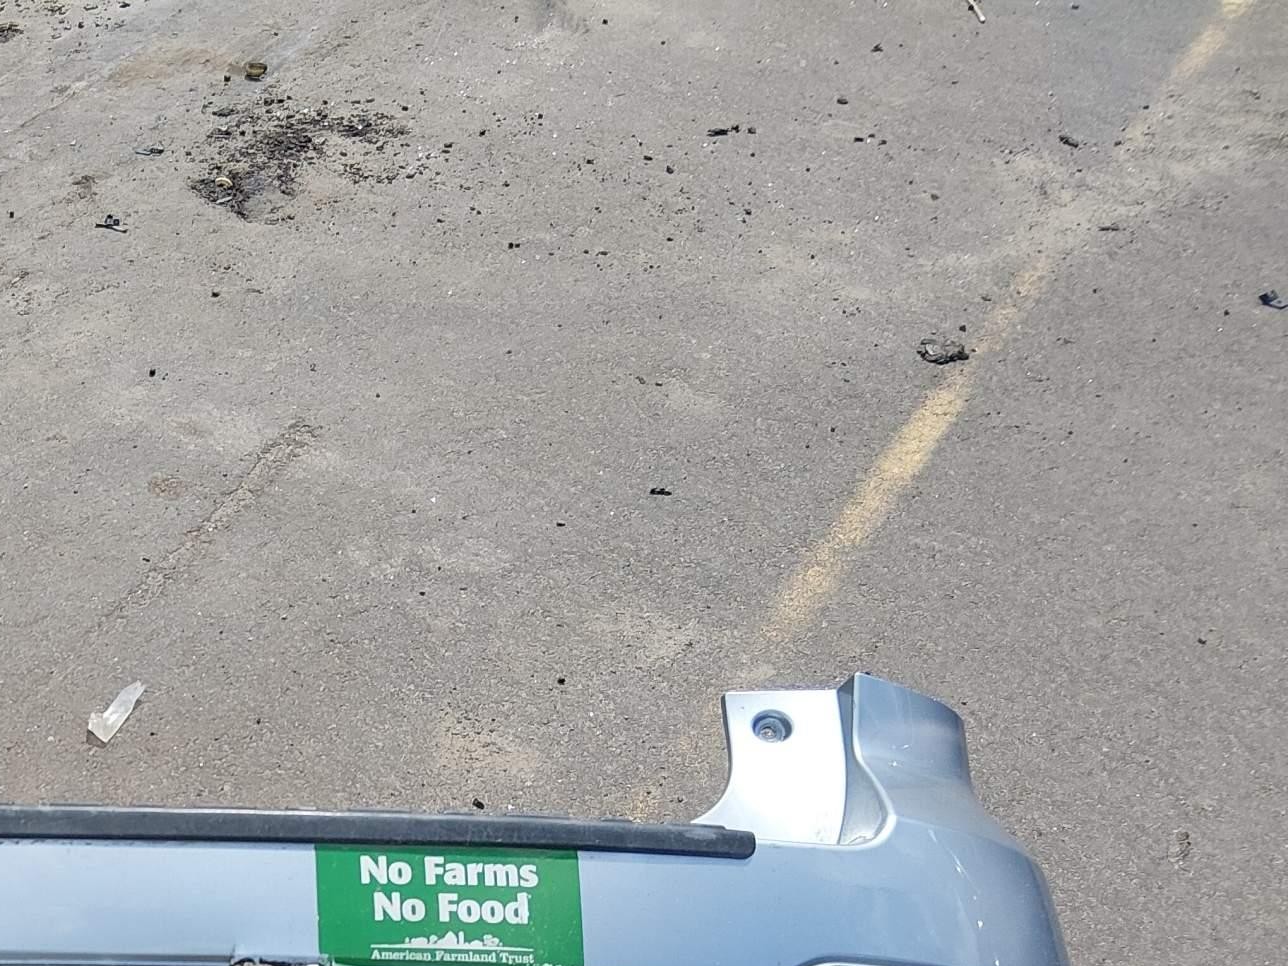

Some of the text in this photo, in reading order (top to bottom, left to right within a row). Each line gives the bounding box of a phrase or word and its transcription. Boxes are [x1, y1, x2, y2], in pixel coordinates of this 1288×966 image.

[360, 855, 539, 888] No Farms
[373, 892, 529, 925] No Food
[371, 949, 535, 965] American Farmland Trust
